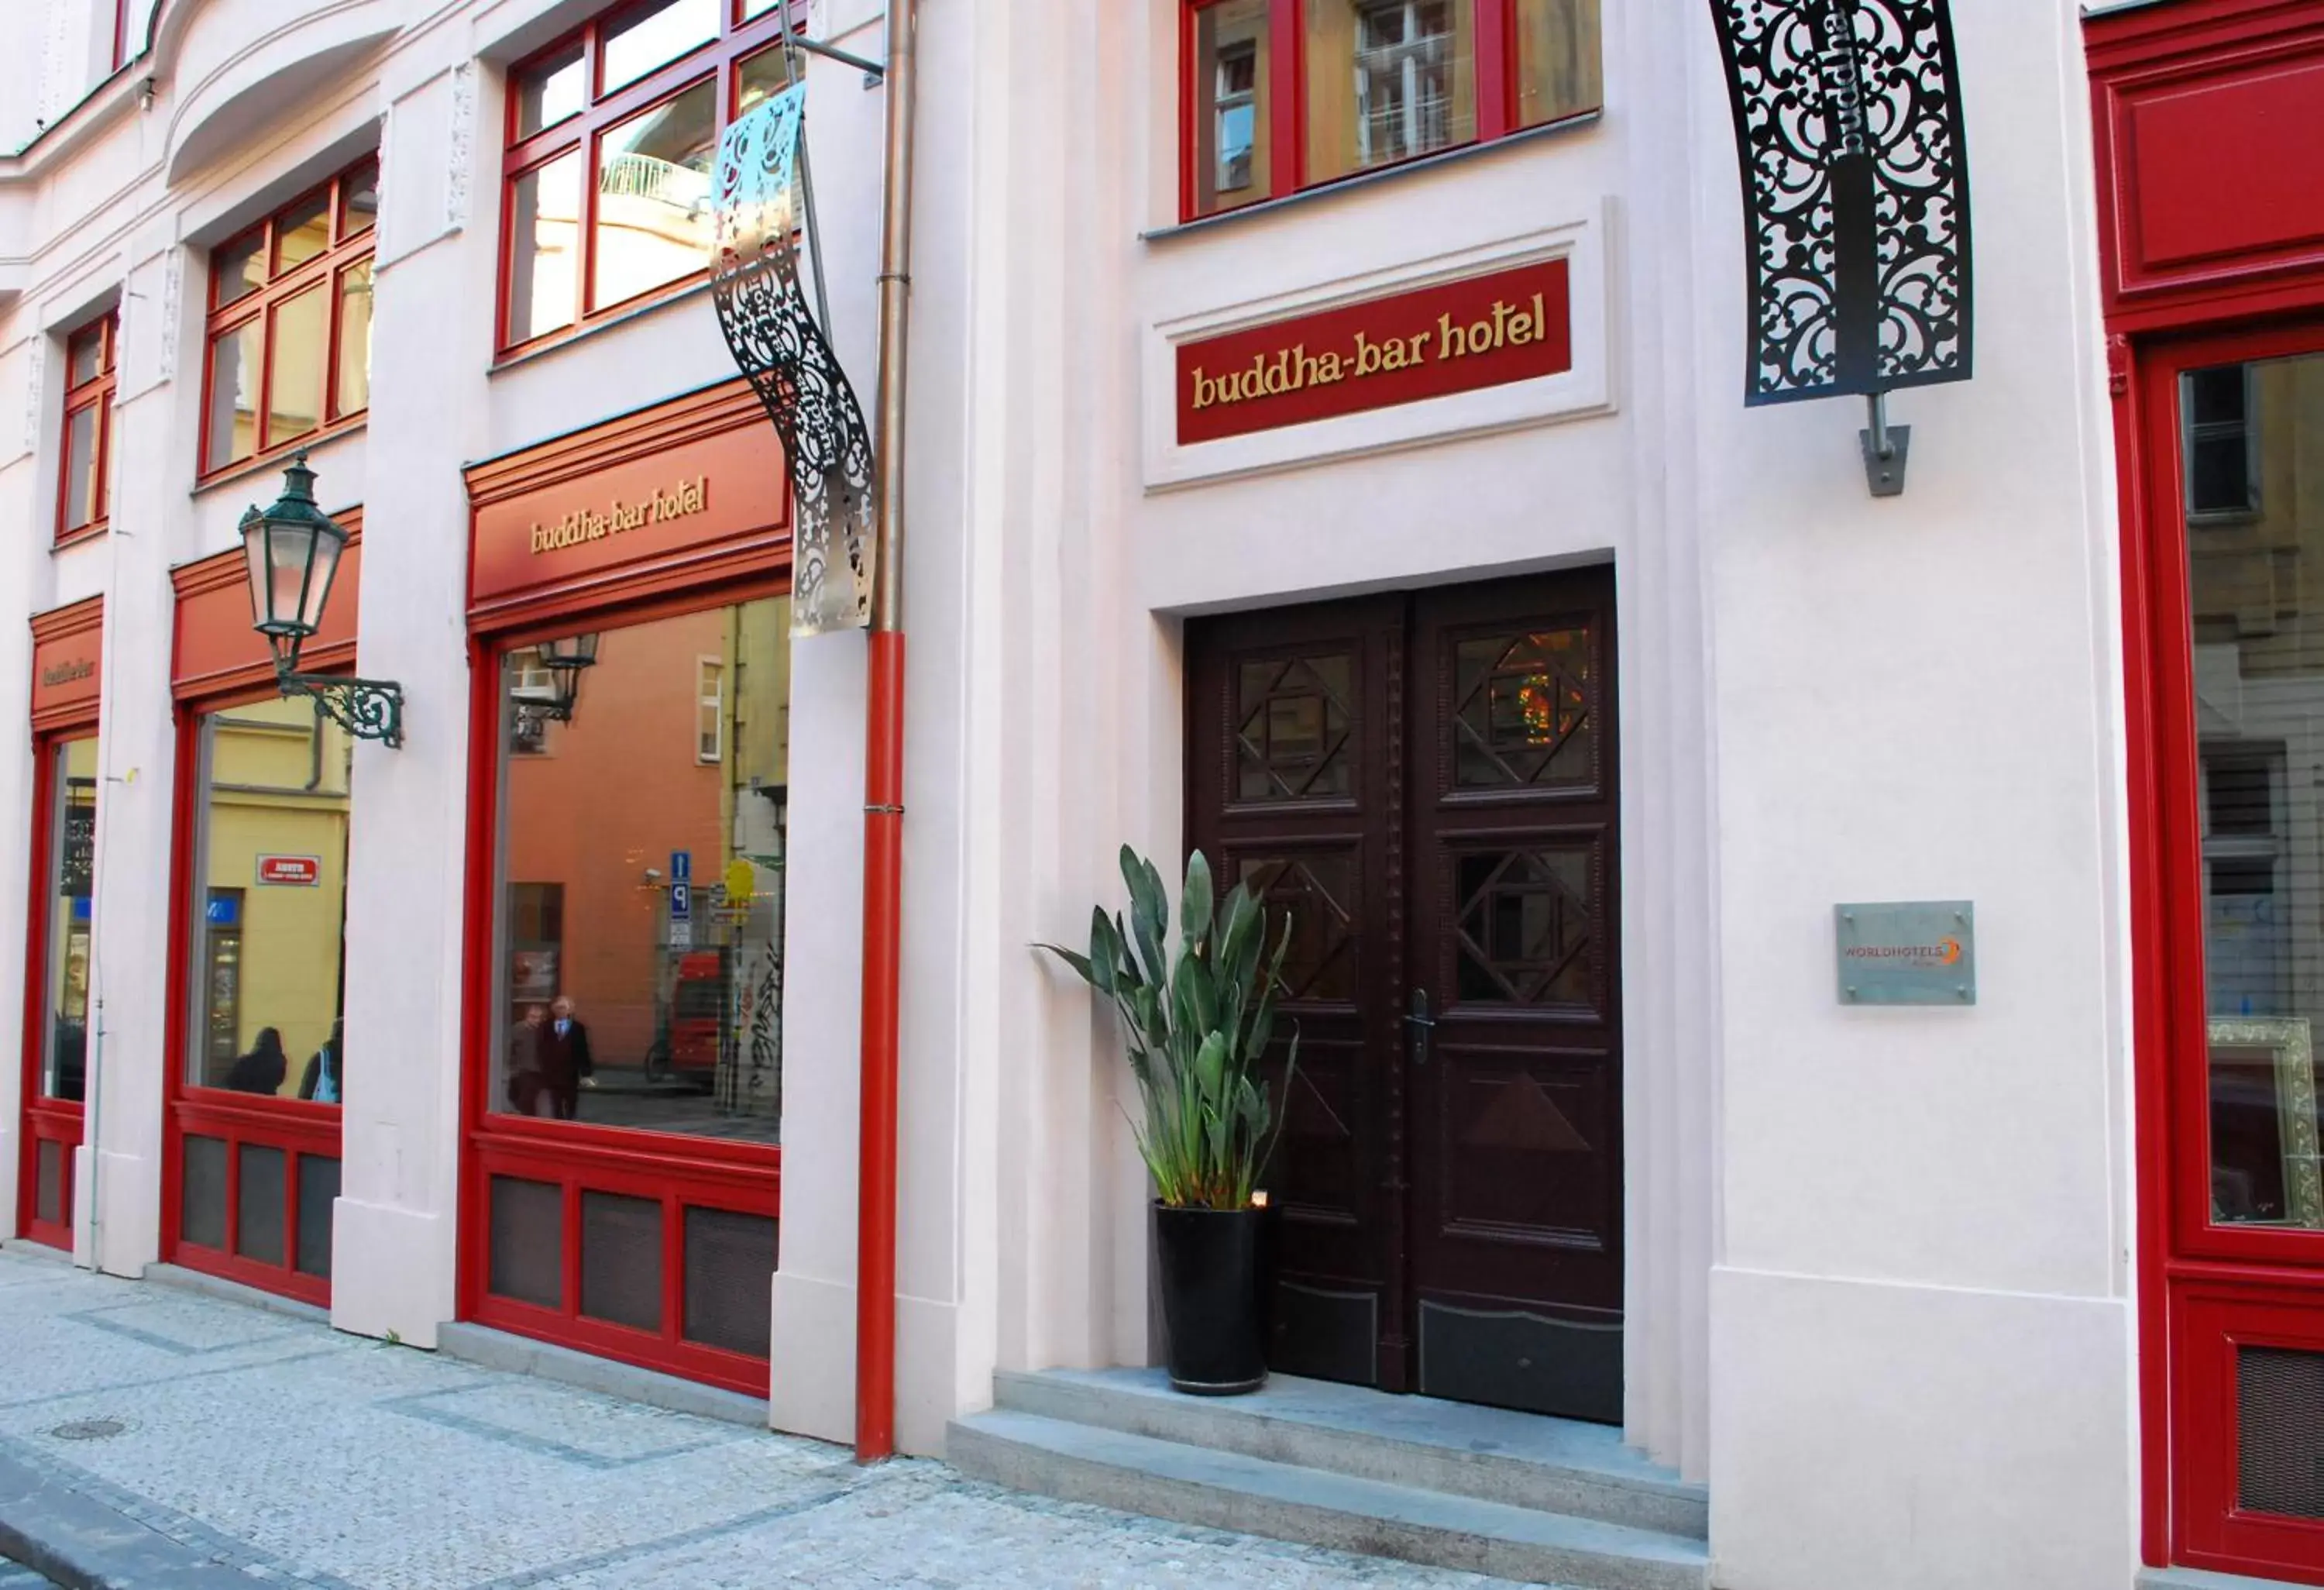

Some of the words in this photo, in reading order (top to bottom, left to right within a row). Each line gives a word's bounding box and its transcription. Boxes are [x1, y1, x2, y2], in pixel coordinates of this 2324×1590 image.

[1191, 330, 1431, 409] buddha-bar
[1437, 293, 1546, 360] hotel
[530, 500, 652, 555] buddha-bar
[651, 473, 707, 523] hotel
[1845, 945, 1943, 958] WORLDHOTELS
